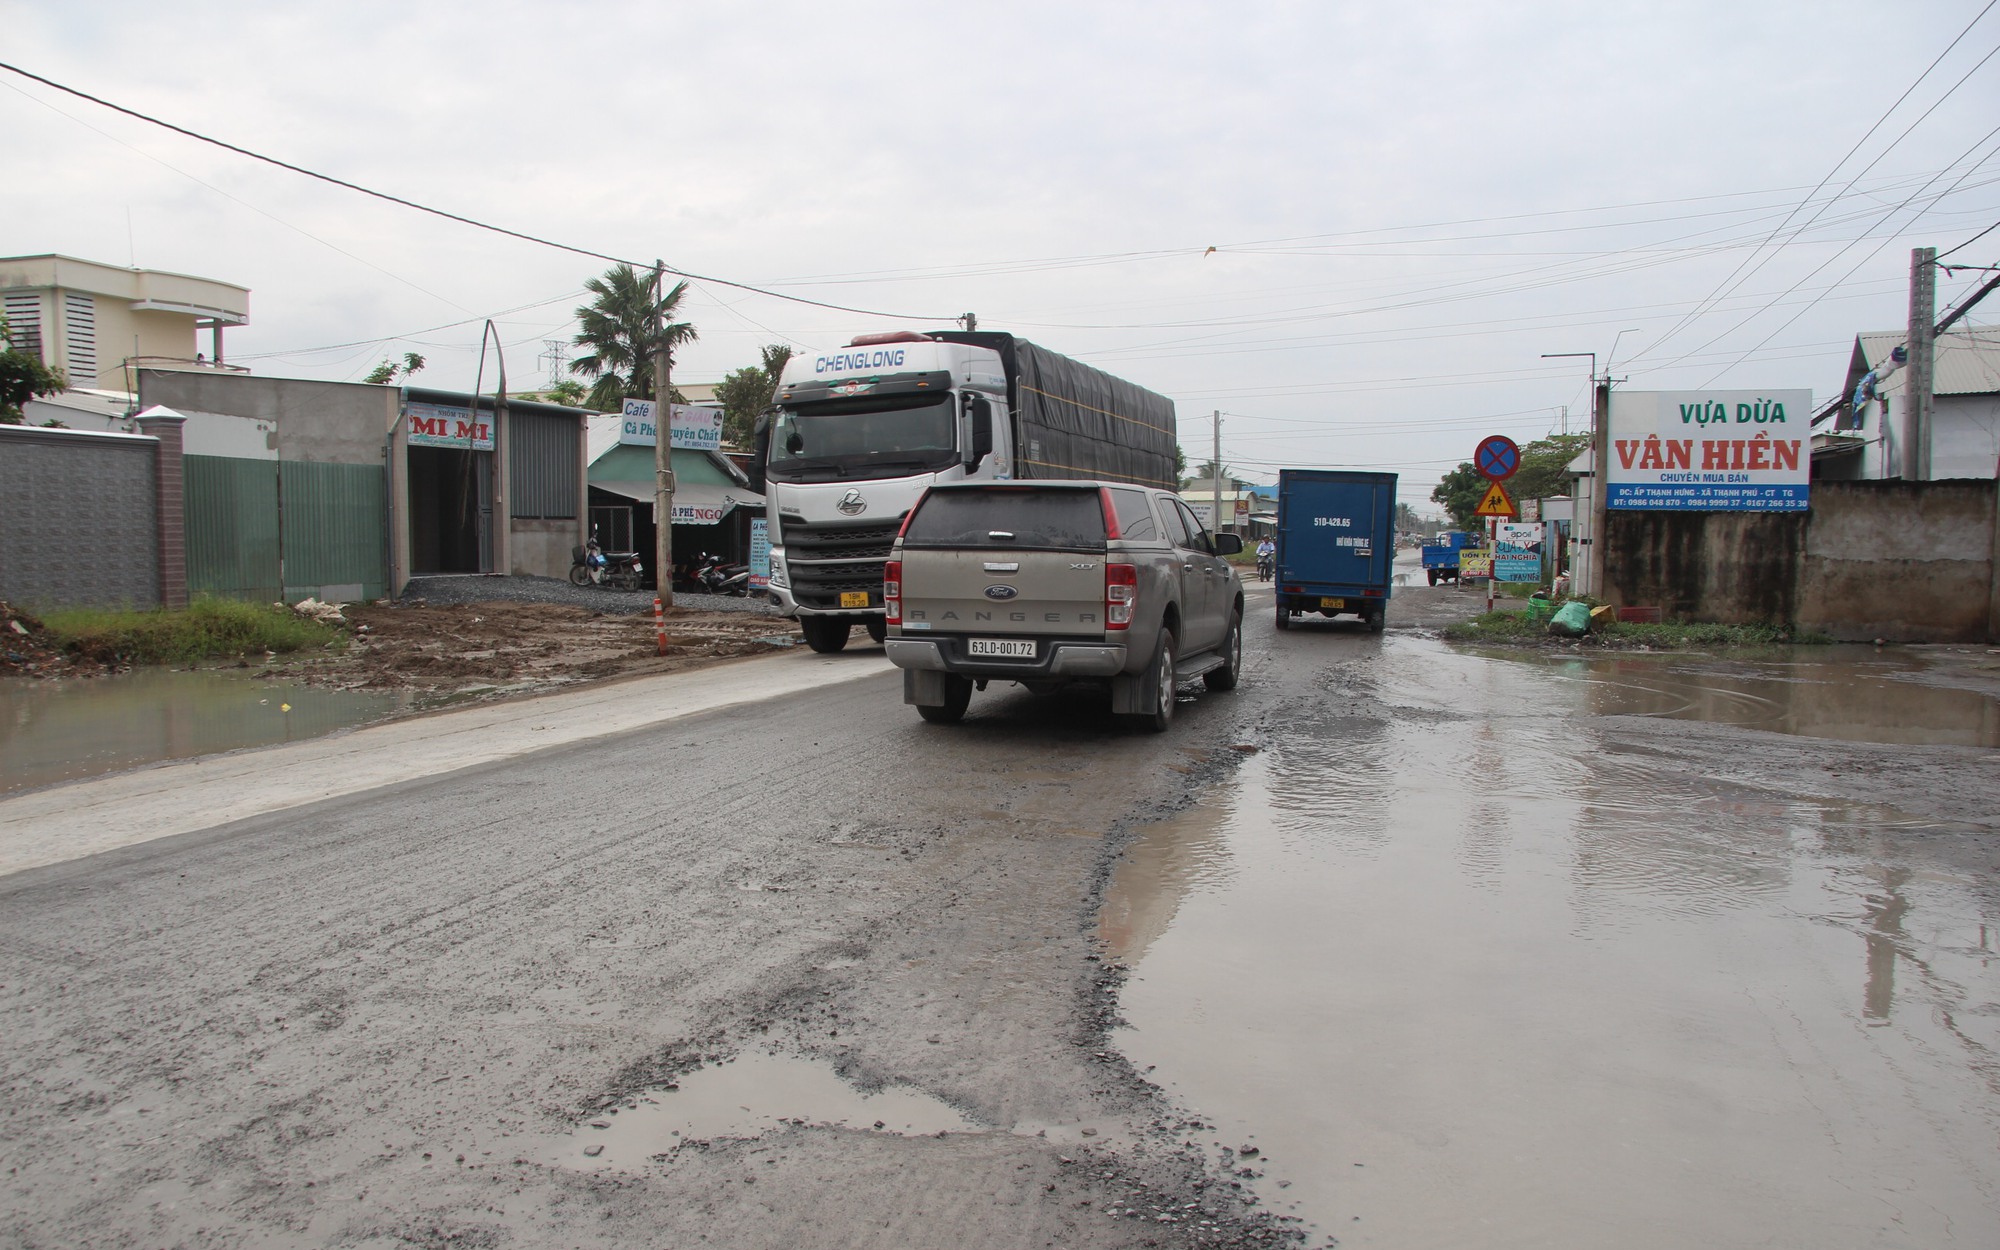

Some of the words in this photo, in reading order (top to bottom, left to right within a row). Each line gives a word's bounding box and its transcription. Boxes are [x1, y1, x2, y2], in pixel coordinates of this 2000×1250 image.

[816, 350, 904, 373] CHENGLONG
[625, 402, 649, 417] Café
[1680, 400, 1727, 428] VỰA
[1737, 398, 1786, 423] DỪA
[412, 416, 448, 436] MI
[456, 421, 489, 440] MI
[625, 419, 637, 434] Cà
[698, 428, 719, 441] Chất
[1615, 434, 1693, 469] VÂN
[1702, 430, 1801, 470] HIỀN
[1660, 471, 1700, 482] CHUYÊN
[1703, 473, 1724, 483] MUA
[1728, 472, 1748, 483] BÁN
[1634, 486, 1644, 496] ẤP
[1647, 489, 1671, 497] THẠNH
[1674, 488, 1695, 496] HƯNG
[1701, 488, 1711, 496] XÃ
[1714, 489, 1739, 498] THẠNH
[1742, 488, 1758, 496] PHÚ
[679, 506, 694, 517] PHÊ
[1314, 517, 1351, 527] 51D-428.65
[1069, 562, 1097, 570] XLT
[991, 586, 1009, 597] Ford
[911, 610, 1096, 623] RANGER
[972, 640, 1032, 655] 63LD-001.72
